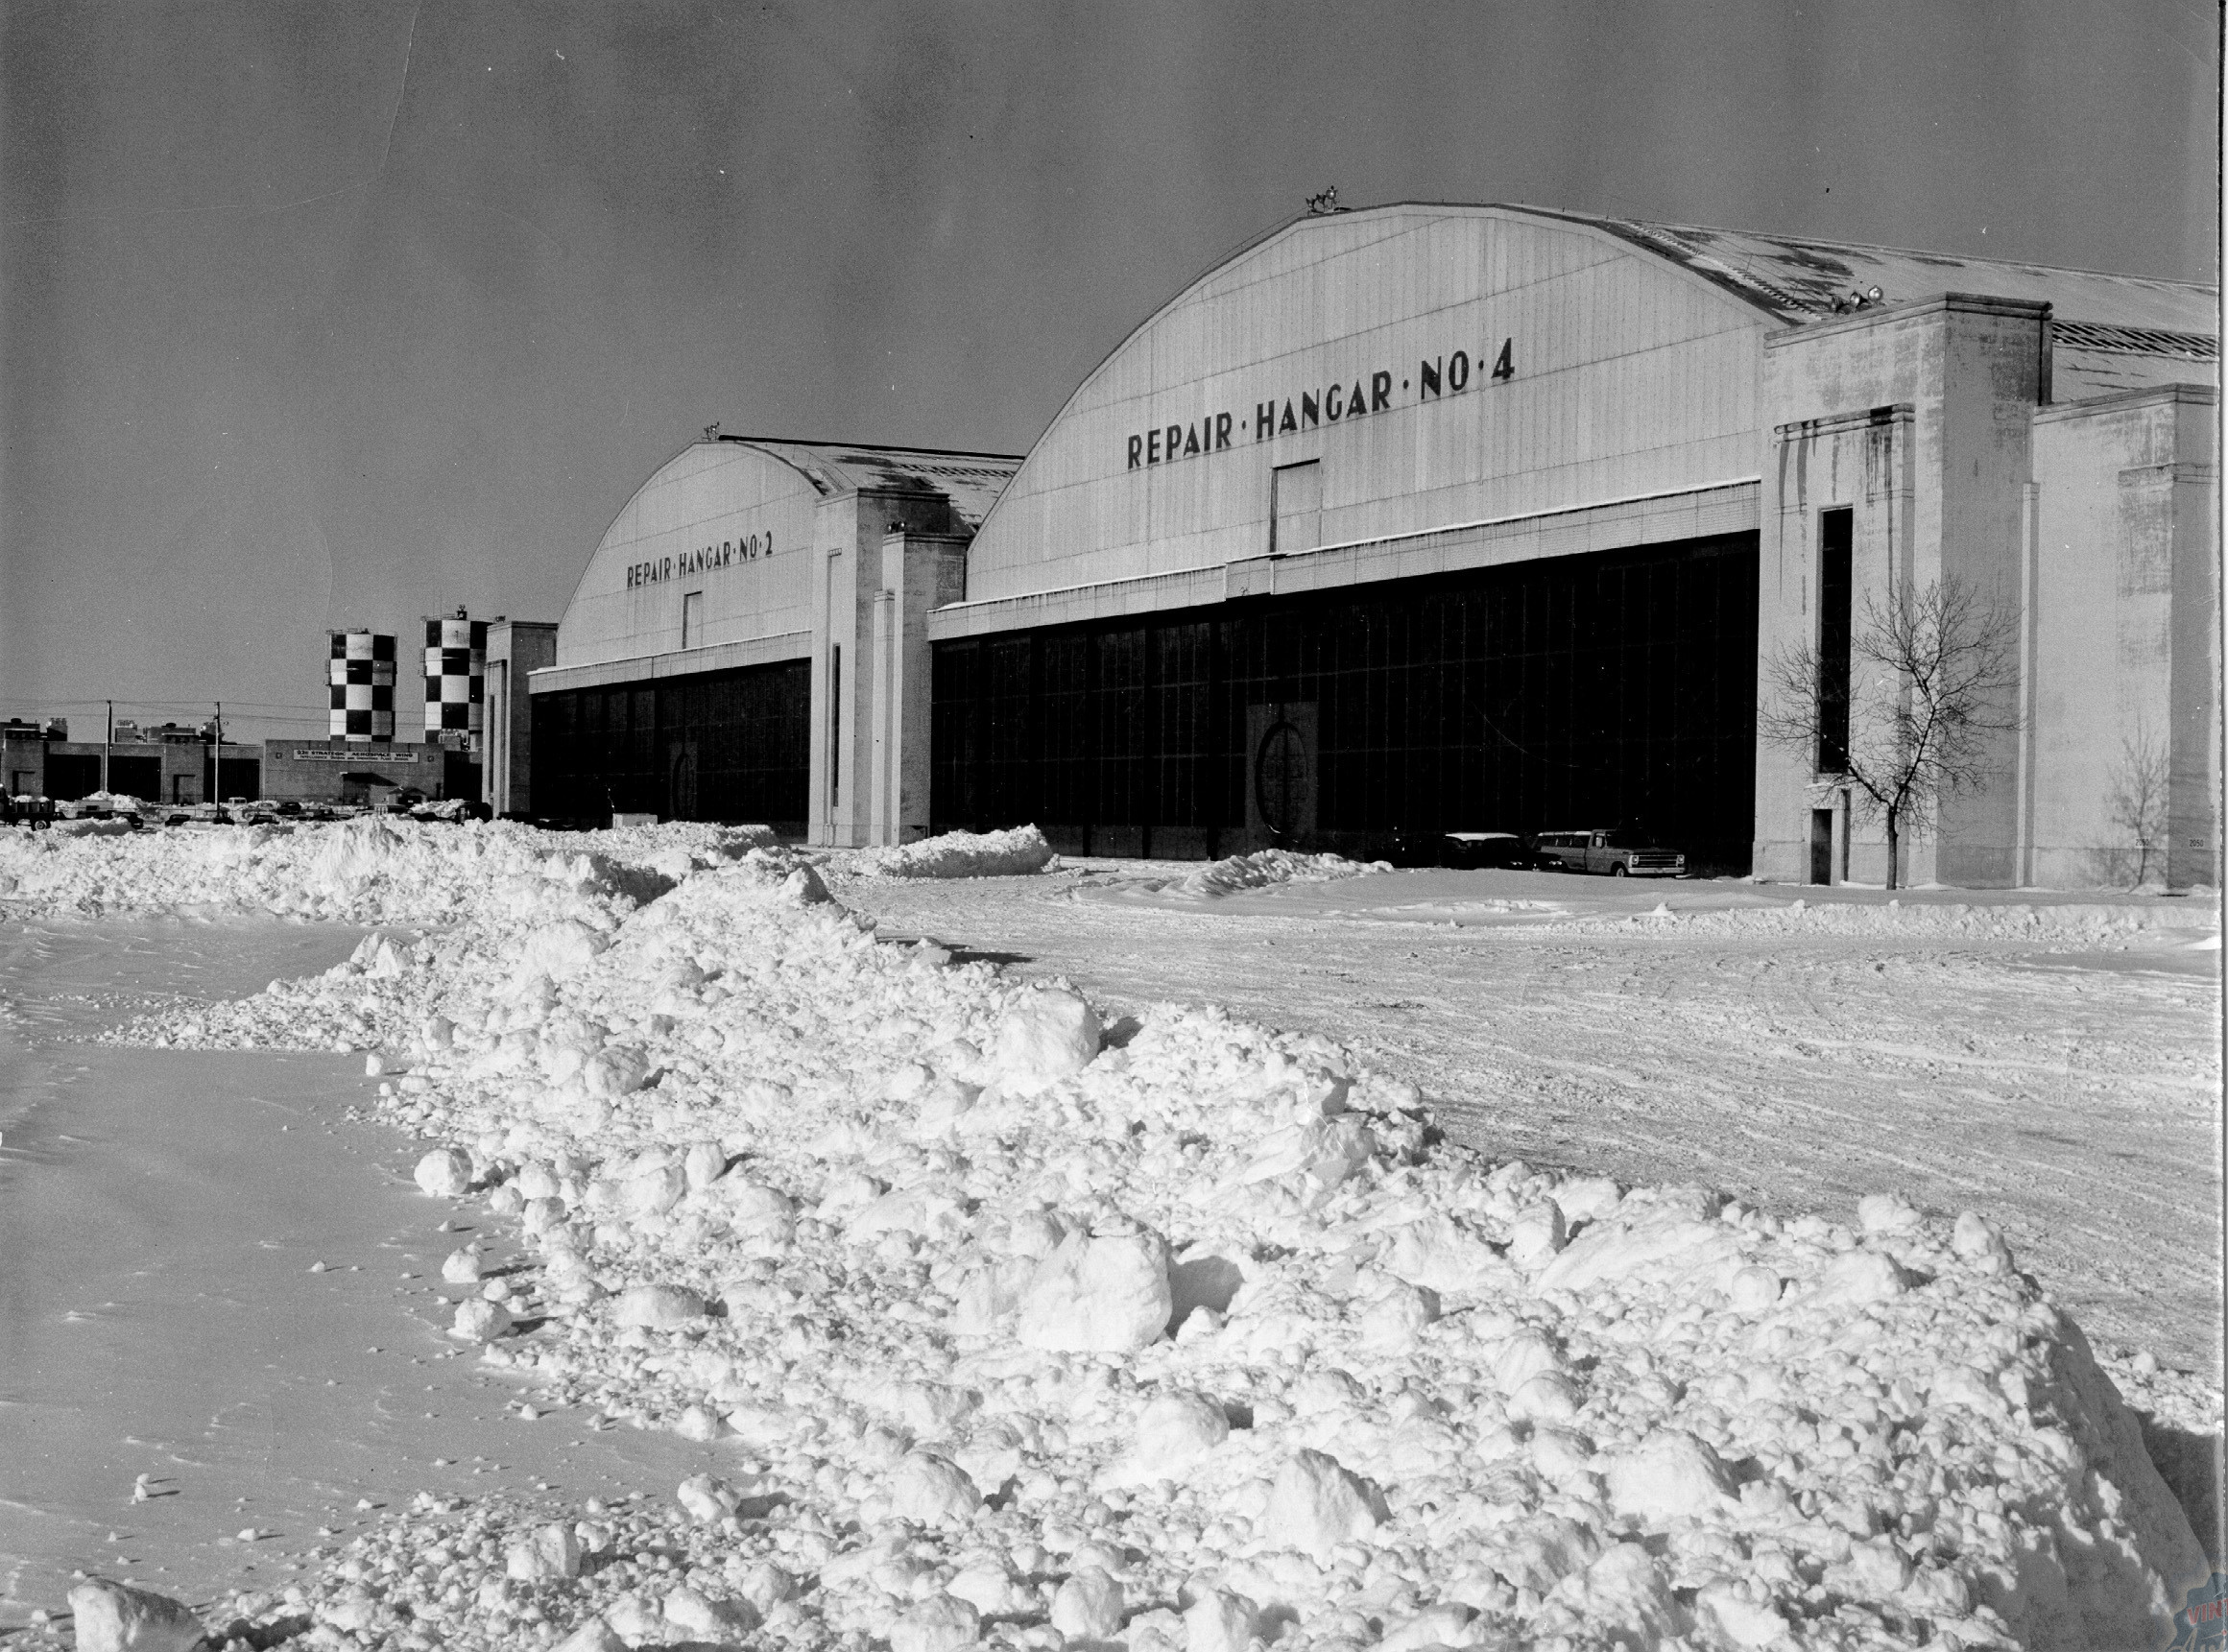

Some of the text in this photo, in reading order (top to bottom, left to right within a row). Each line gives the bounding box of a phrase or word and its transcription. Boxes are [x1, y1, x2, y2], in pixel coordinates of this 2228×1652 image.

[1127, 412, 1233, 470] REPAIR
[1256, 370, 1393, 440] HANGAR
[1491, 337, 1516, 381] 4
[627, 557, 671, 587] REPAIR
[679, 541, 731, 576] HANGAR
[765, 530, 773, 556] 2
